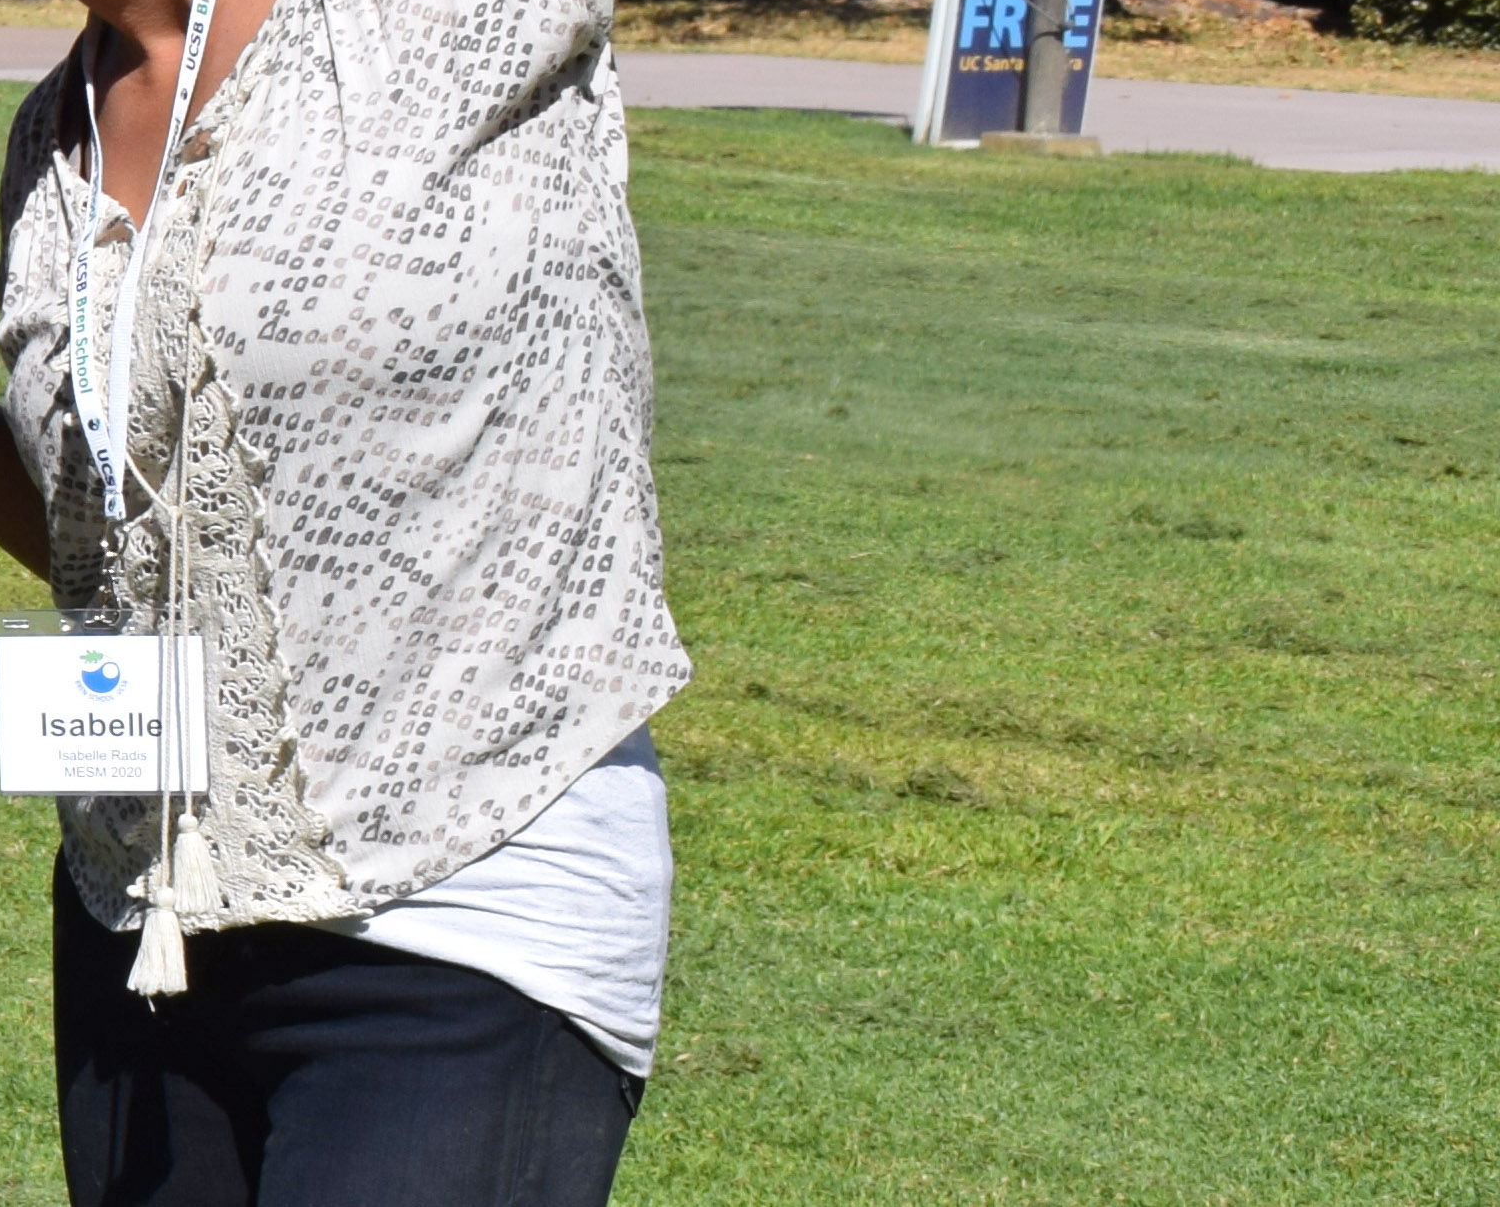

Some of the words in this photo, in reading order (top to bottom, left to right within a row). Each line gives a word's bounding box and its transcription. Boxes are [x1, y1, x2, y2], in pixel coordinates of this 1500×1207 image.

[185, 21, 204, 71] UCSB
[76, 251, 89, 293] UCSB
[76, 296, 87, 334] Bren
[76, 337, 94, 394] School
[97, 448, 116, 486] UCS
[41, 712, 163, 737] Isabelle
[58, 749, 107, 761] Isabelle
[111, 749, 148, 761] Radis
[64, 766, 107, 778] MESM
[111, 766, 142, 778] 2020
